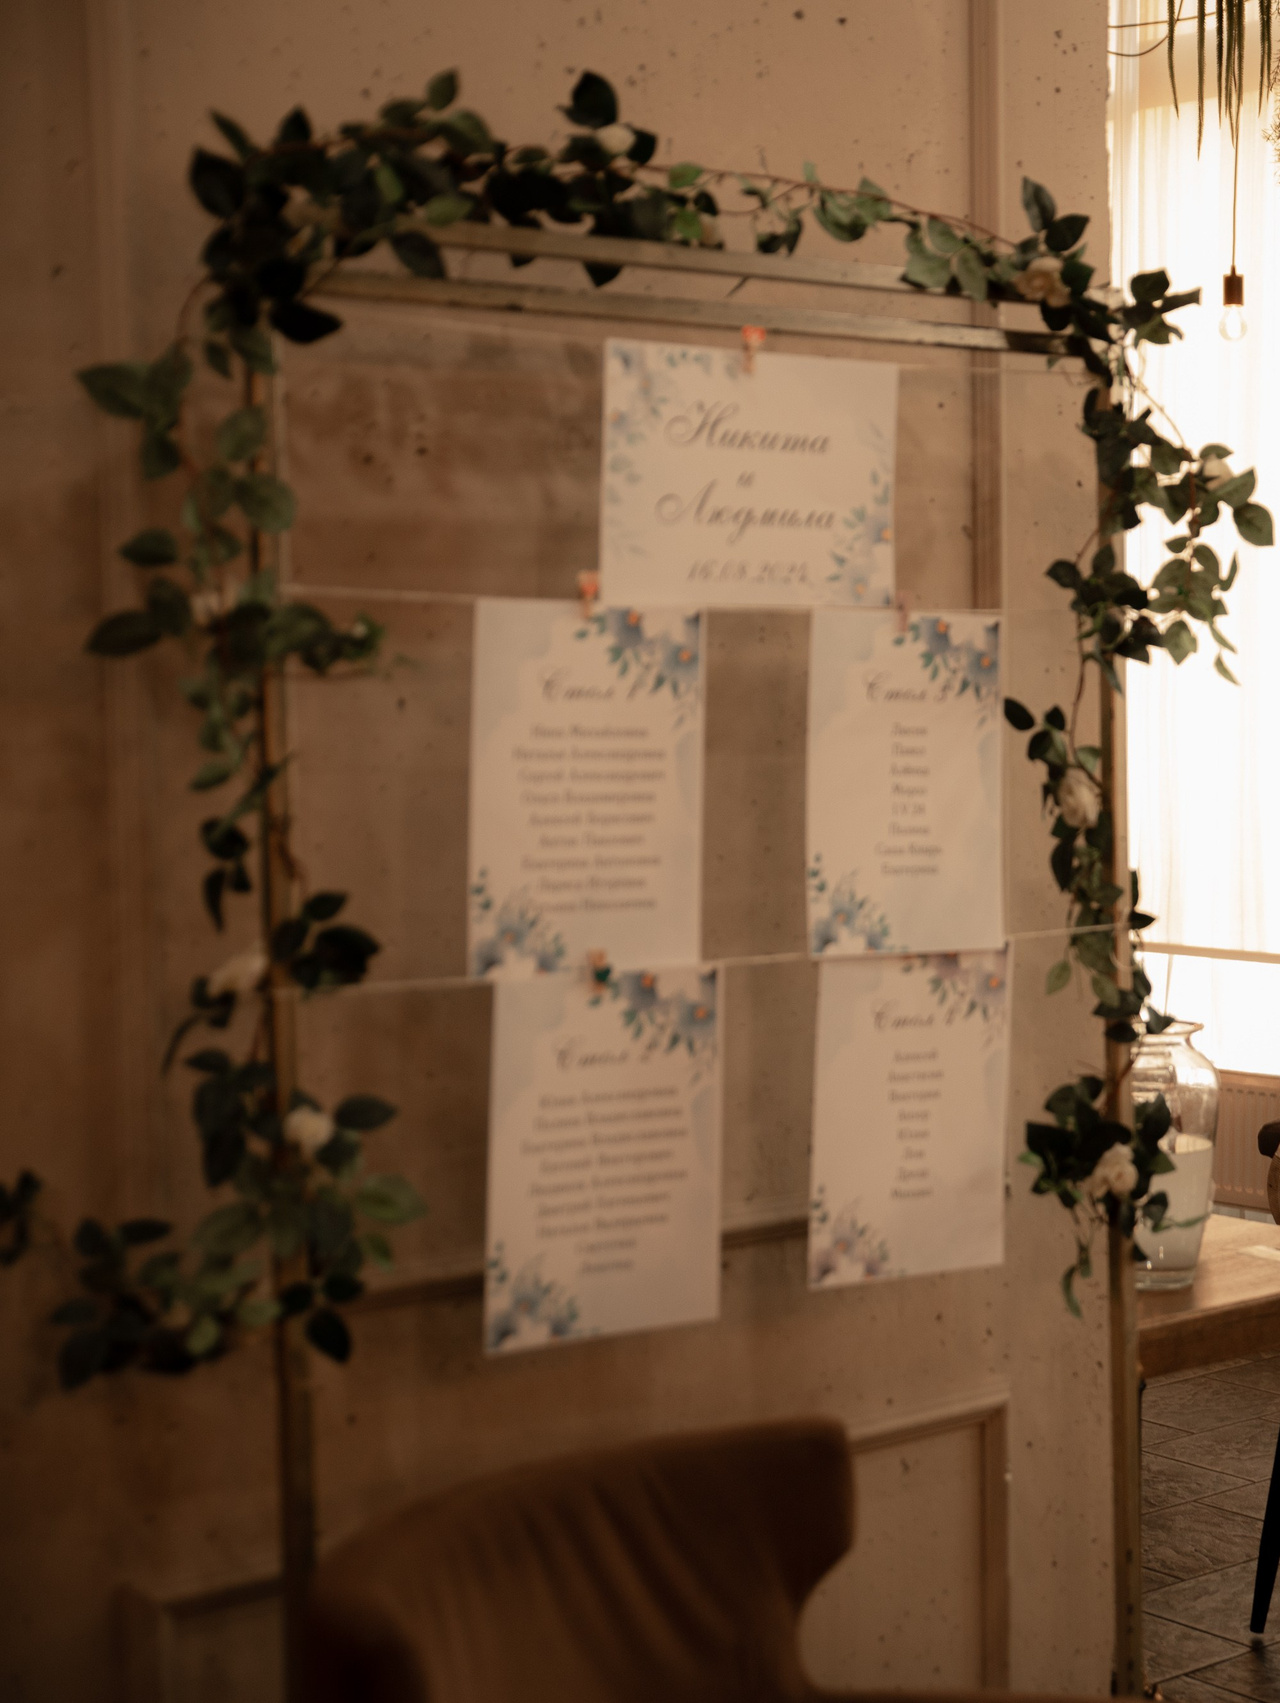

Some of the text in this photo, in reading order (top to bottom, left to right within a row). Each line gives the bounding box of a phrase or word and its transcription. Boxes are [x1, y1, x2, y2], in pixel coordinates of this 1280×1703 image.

[663, 399, 831, 454] Никита
[736, 470, 756, 489] и
[654, 478, 836, 547] Людмила
[865, 669, 927, 703] Стол
